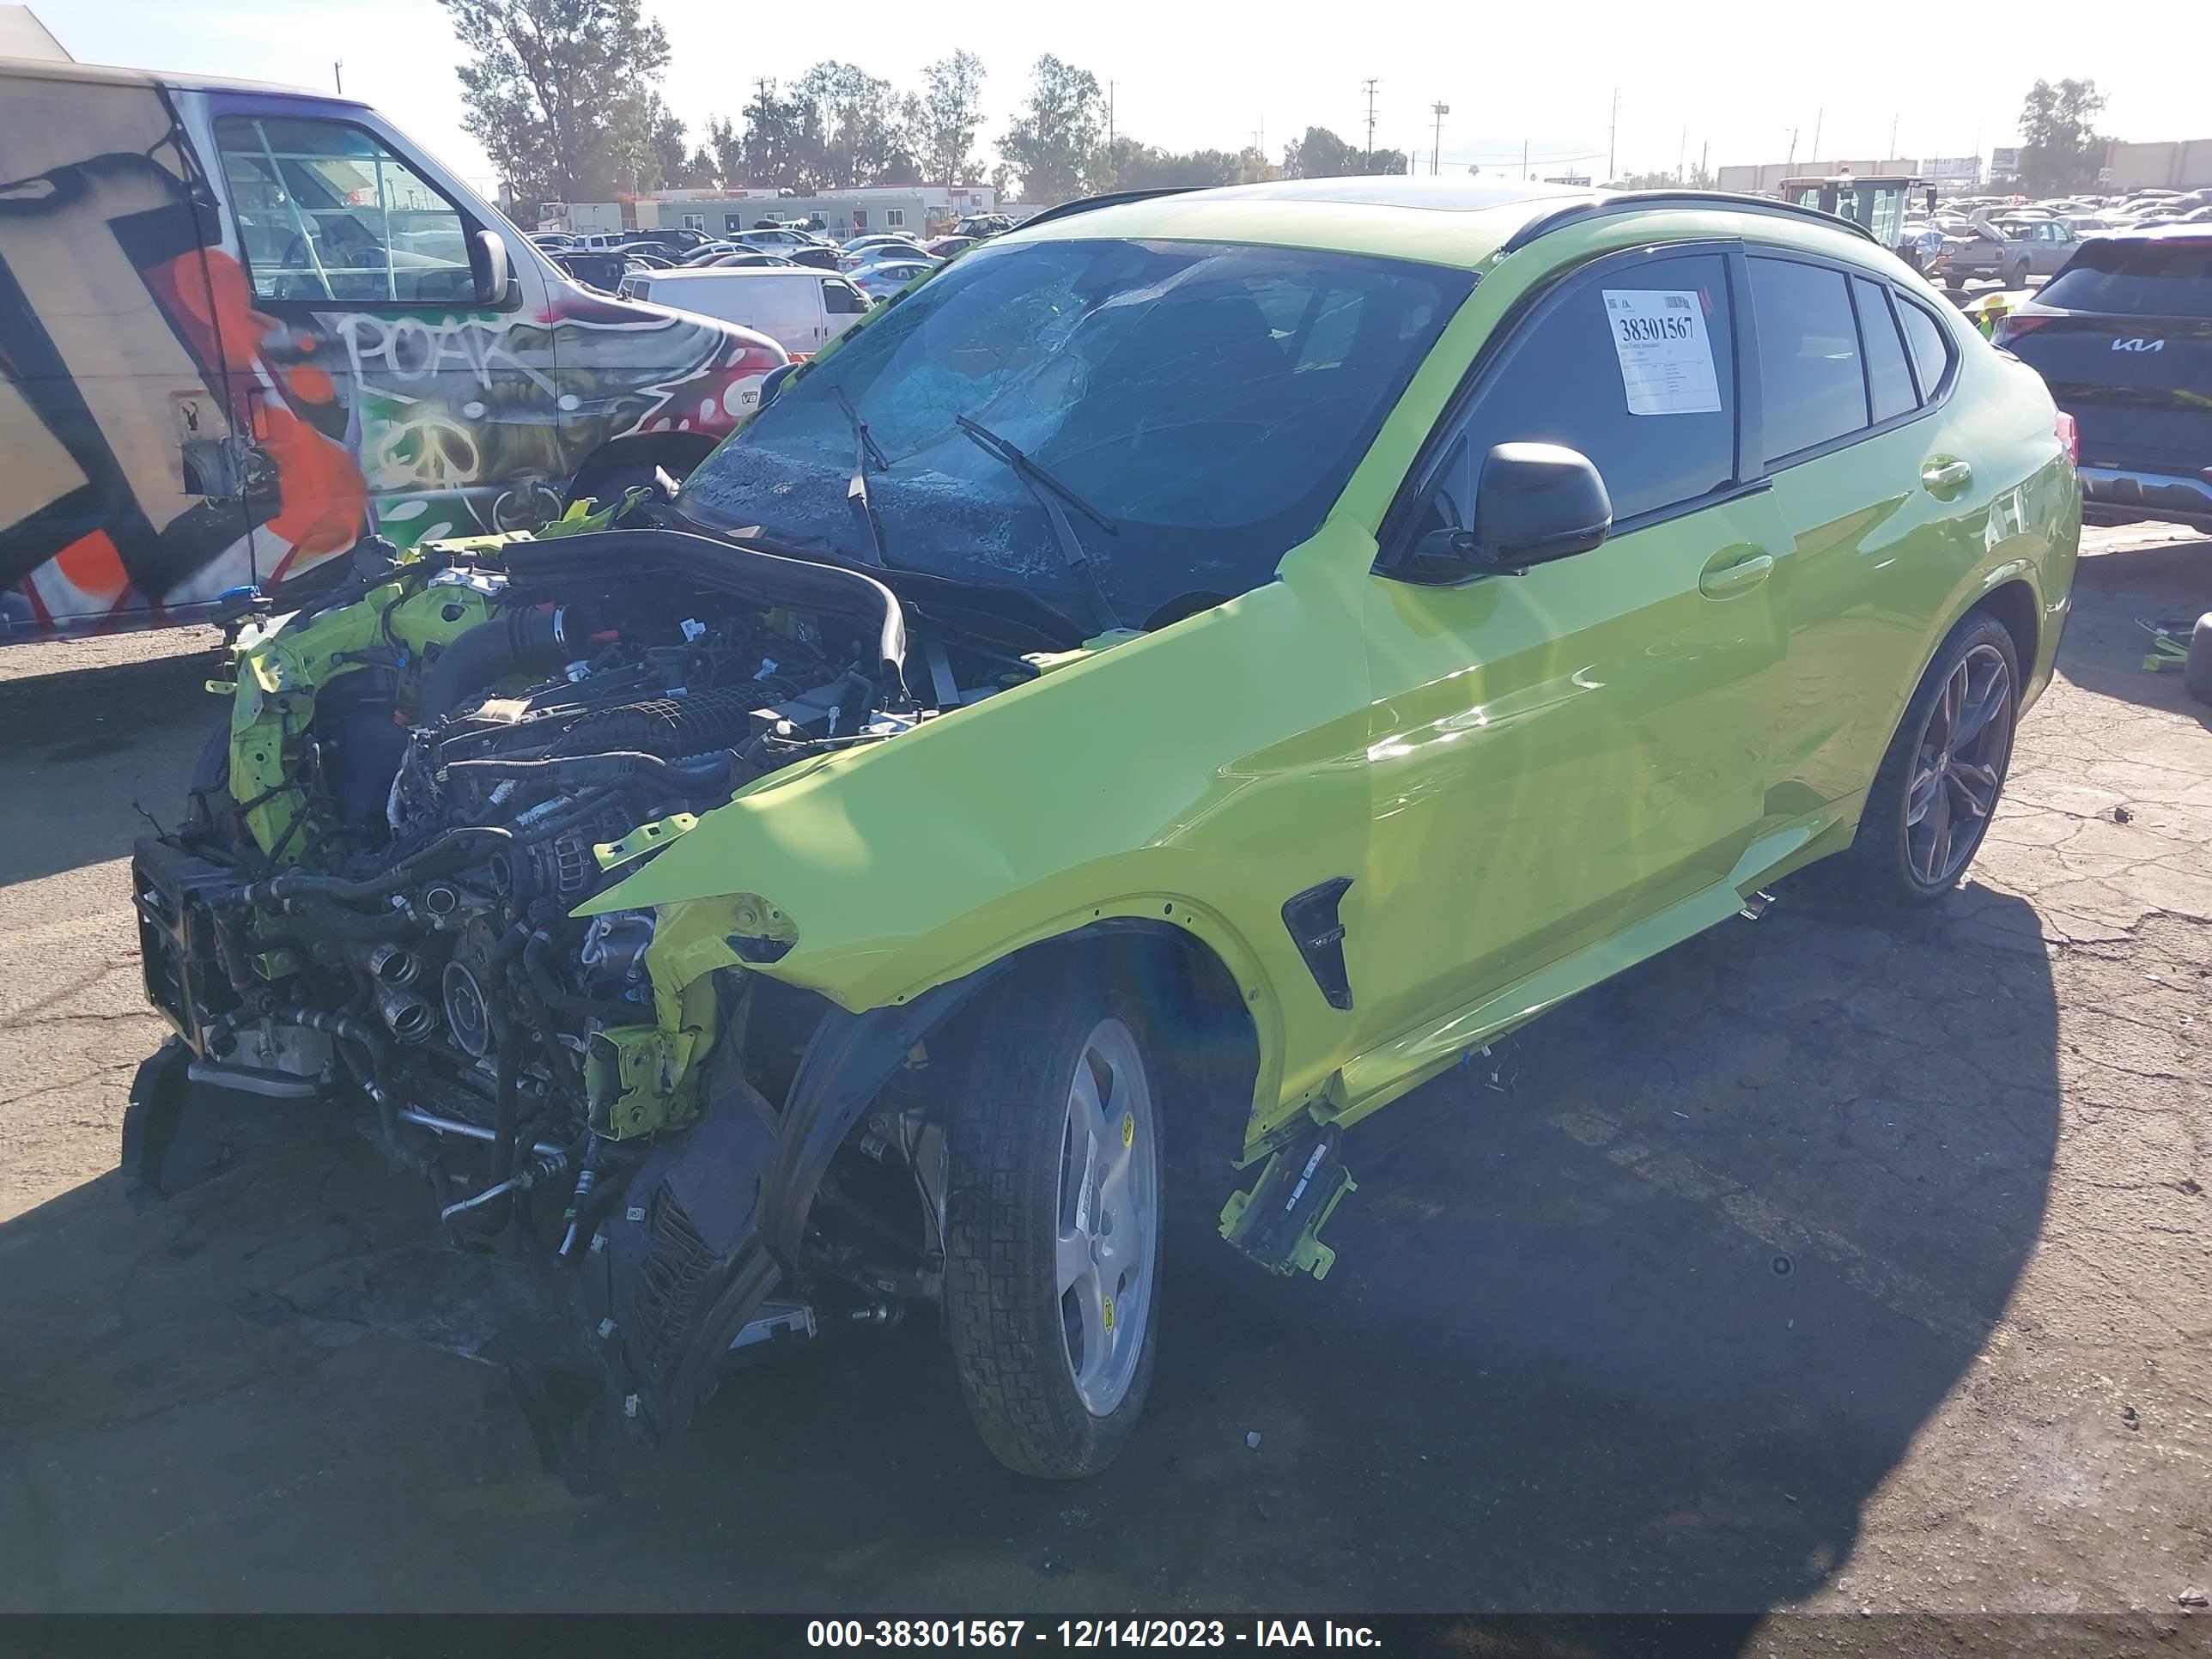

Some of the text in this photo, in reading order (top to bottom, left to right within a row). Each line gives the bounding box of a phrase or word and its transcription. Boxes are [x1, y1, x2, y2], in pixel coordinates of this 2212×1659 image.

[1620, 316, 1693, 342] 38301567
[2112, 338, 2165, 351] KIA
[742, 394, 757, 404] V8
